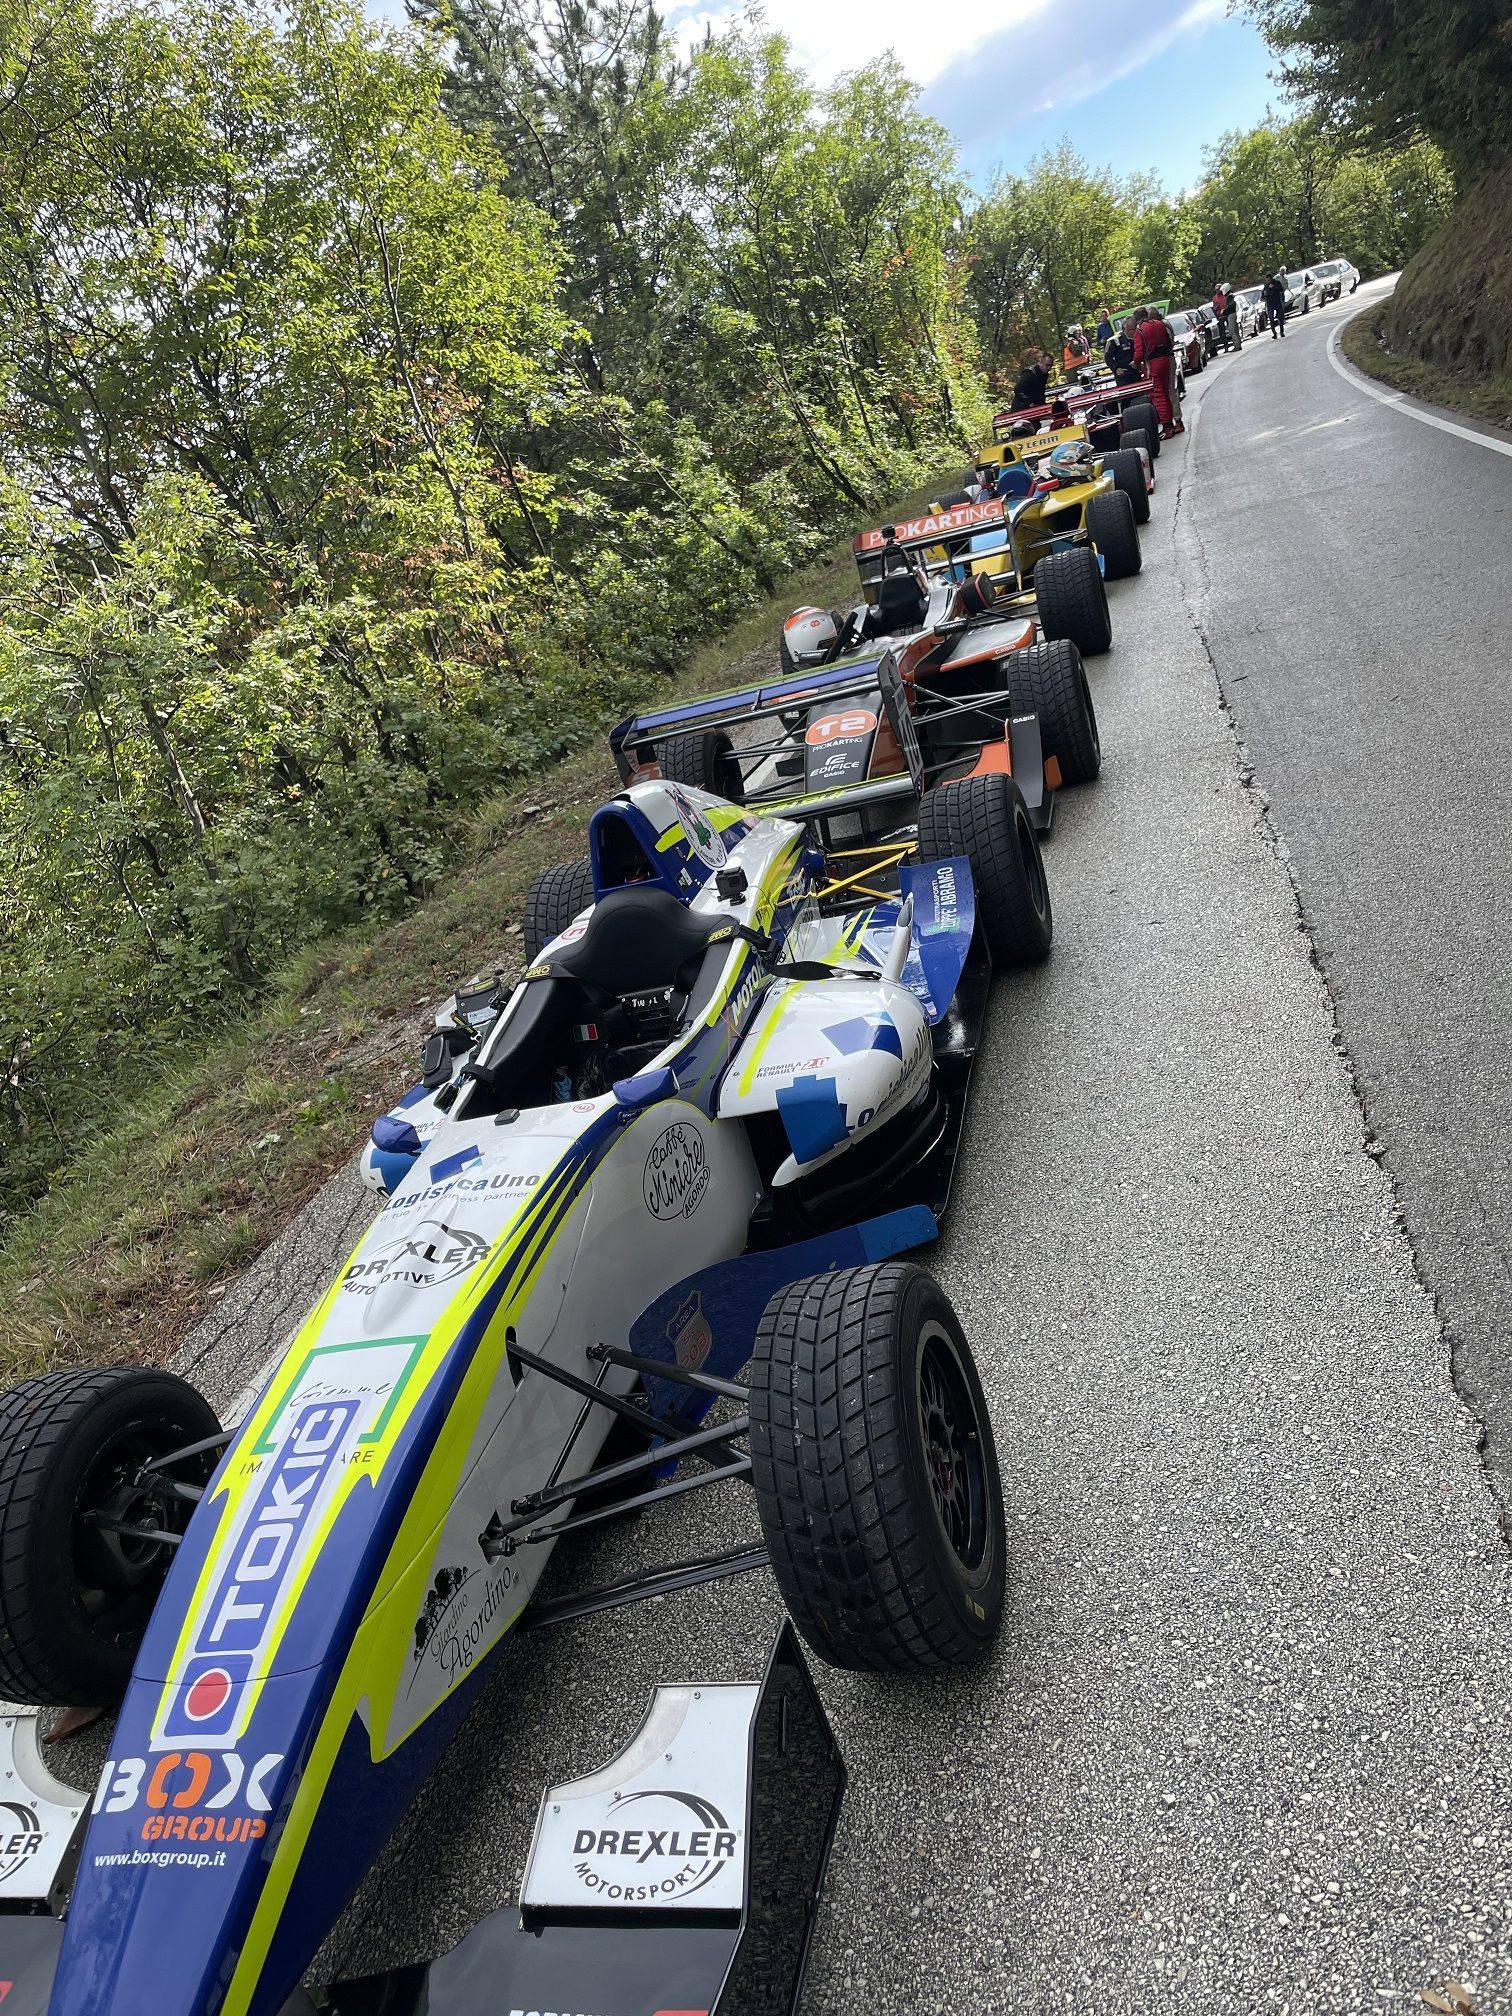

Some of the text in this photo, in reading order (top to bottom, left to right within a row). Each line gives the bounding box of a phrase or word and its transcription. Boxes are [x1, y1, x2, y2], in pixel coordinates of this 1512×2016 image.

[869, 503, 1000, 546] POKARTING
[995, 644, 1016, 655] CASIO
[815, 716, 866, 737] T2
[1012, 715, 1036, 724] CASIO
[812, 737, 863, 752] PROKARTING
[809, 761, 860, 777] EDIFICE
[823, 770, 845, 778] CASIO
[936, 866, 957, 906] ABRAMO
[709, 926, 734, 942] OMP
[525, 964, 551, 979] OMP
[756, 1067, 796, 1078] RENAULT
[758, 1056, 830, 1073] FORMULA 2.0
[649, 1140, 704, 1214] Miniere
[381, 1174, 541, 1212] LogistcaUno
[483, 1191, 530, 1203] partner
[684, 1168, 709, 1217] AGORDO
[343, 1240, 493, 1281] DRXLER
[341, 1271, 436, 1296] AUTOOTIVE
[675, 1305, 696, 1332] AREA
[208, 1407, 349, 1642] TOKIĆ
[430, 1593, 469, 1663] Giardino
[440, 1566, 512, 1689] Agordino
[91, 1752, 285, 1815] BOX
[141, 1815, 268, 1843] GROUP
[94, 1849, 227, 1868] www.boxgroup.it
[572, 1828, 738, 1864] DREXLER
[573, 1860, 699, 1902] MOTORSPORT
